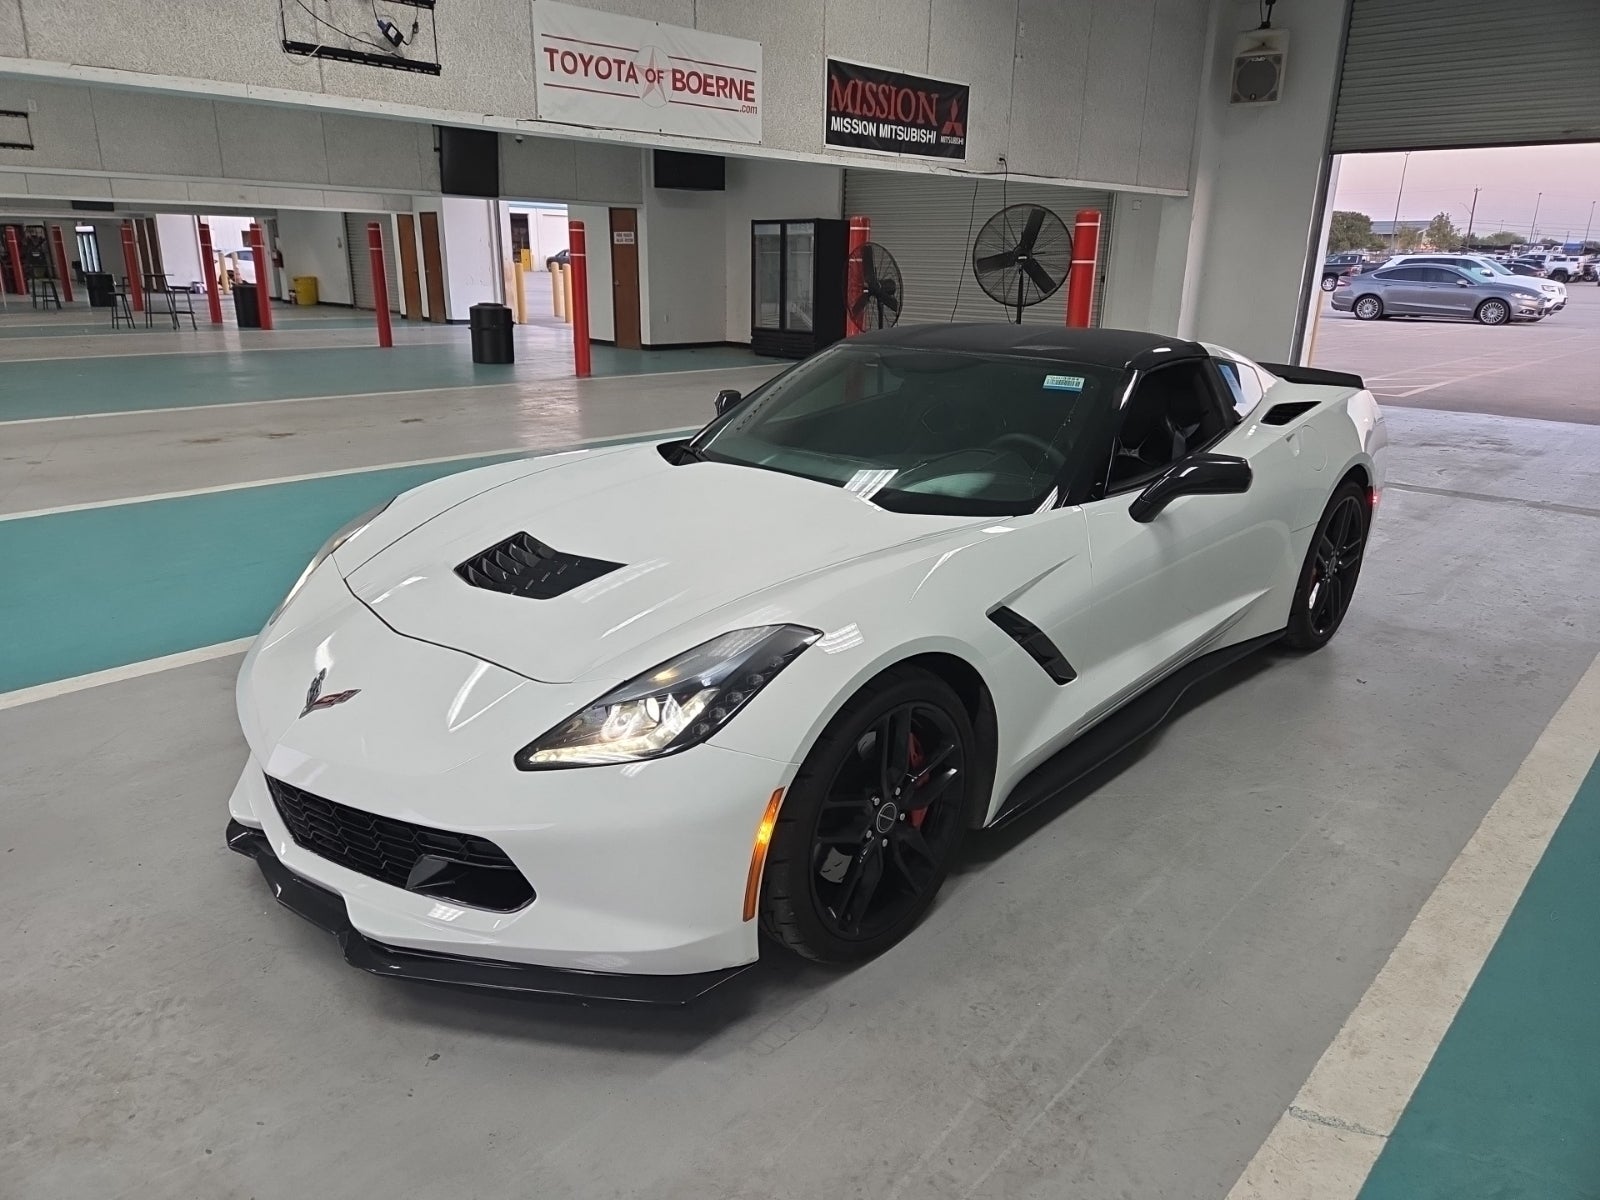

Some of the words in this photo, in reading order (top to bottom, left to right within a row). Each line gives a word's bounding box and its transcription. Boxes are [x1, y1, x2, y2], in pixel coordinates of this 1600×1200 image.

[543, 47, 639, 84] TOYOTA
[645, 67, 664, 84] OF
[671, 68, 756, 103] BOERNE
[739, 104, 758, 115] .com
[830, 74, 939, 127] MISSION
[830, 116, 877, 137] MISSION
[879, 123, 937, 144] MITSUBISHI
[940, 136, 964, 146] MITSUBISHI
